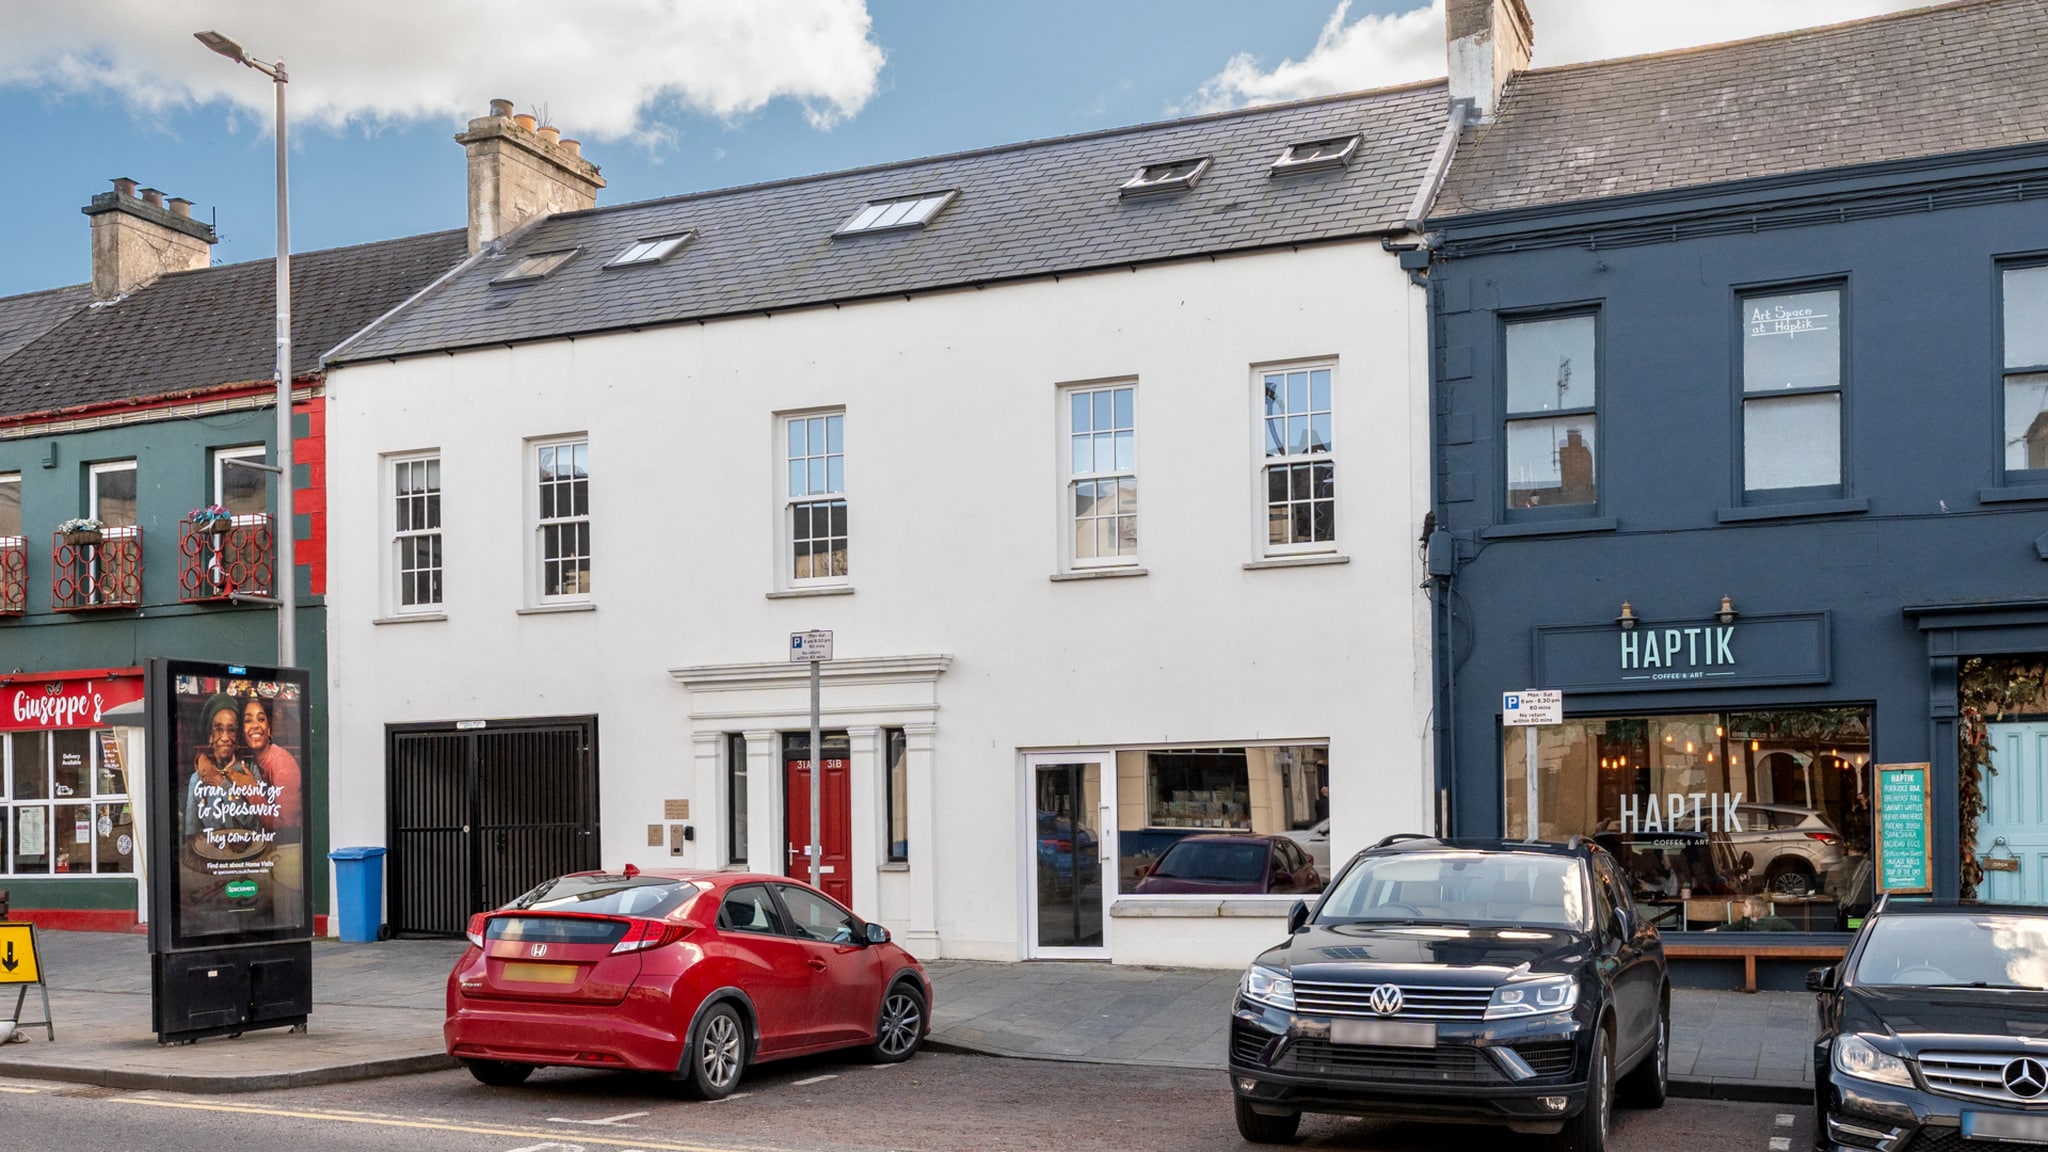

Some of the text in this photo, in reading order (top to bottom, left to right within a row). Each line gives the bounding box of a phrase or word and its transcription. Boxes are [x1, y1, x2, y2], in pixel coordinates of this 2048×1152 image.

[1752, 305, 1812, 324] Art Space
[1752, 319, 1813, 339] at Haptik
[1620, 626, 1736, 668] HAPTIK
[14, 681, 104, 726] Giuseppe's
[796, 760, 842, 769] 31A 31B
[1891, 774, 1914, 782] HAPTIK
[194, 780, 284, 804] Gran doesn't go
[198, 798, 281, 822] to Specsavers
[1620, 792, 1743, 833] HAPTIK
[203, 828, 276, 849] They come to her
